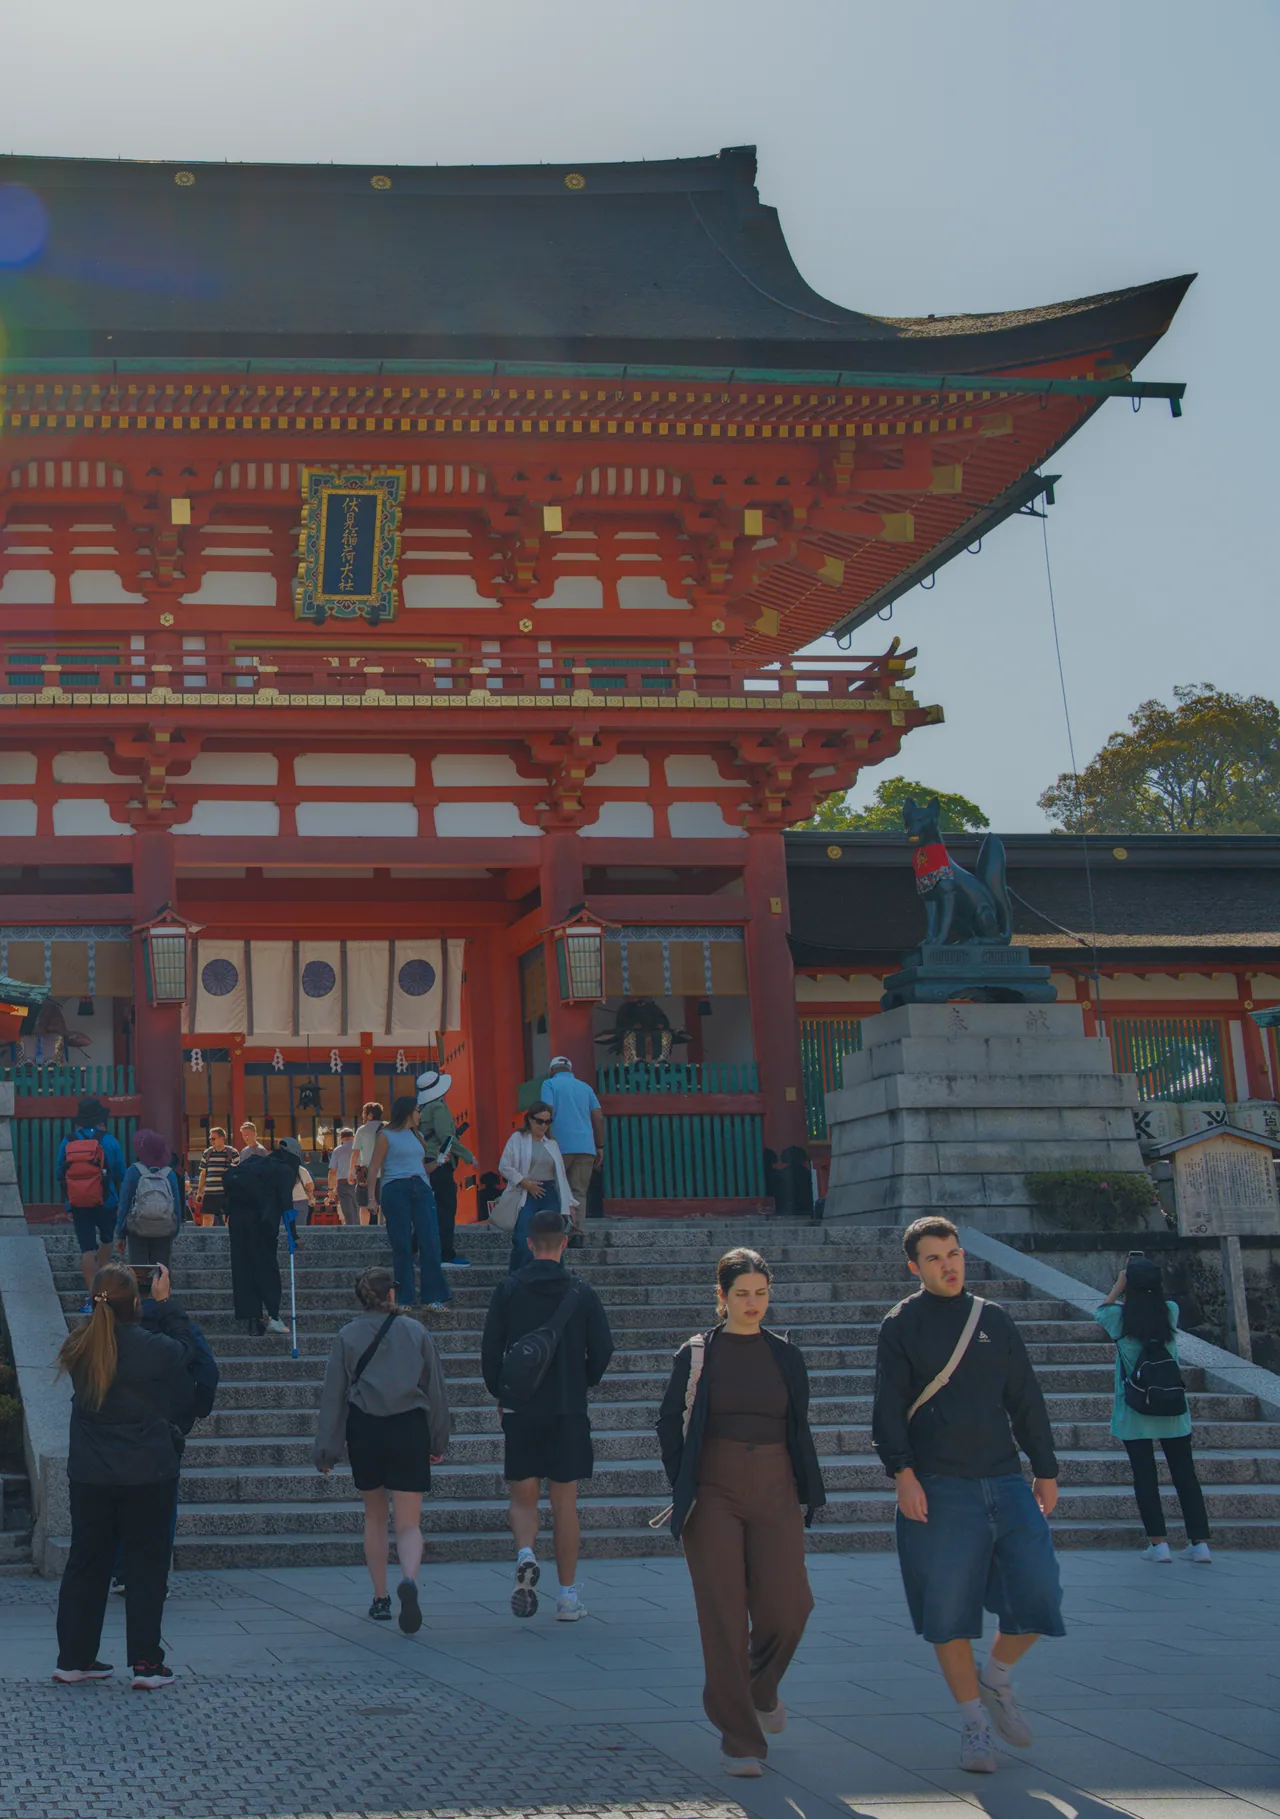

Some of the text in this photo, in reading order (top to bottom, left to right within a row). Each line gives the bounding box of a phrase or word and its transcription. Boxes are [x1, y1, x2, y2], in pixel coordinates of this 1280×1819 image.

[339, 497, 361, 591] 伏見稲荷大社
